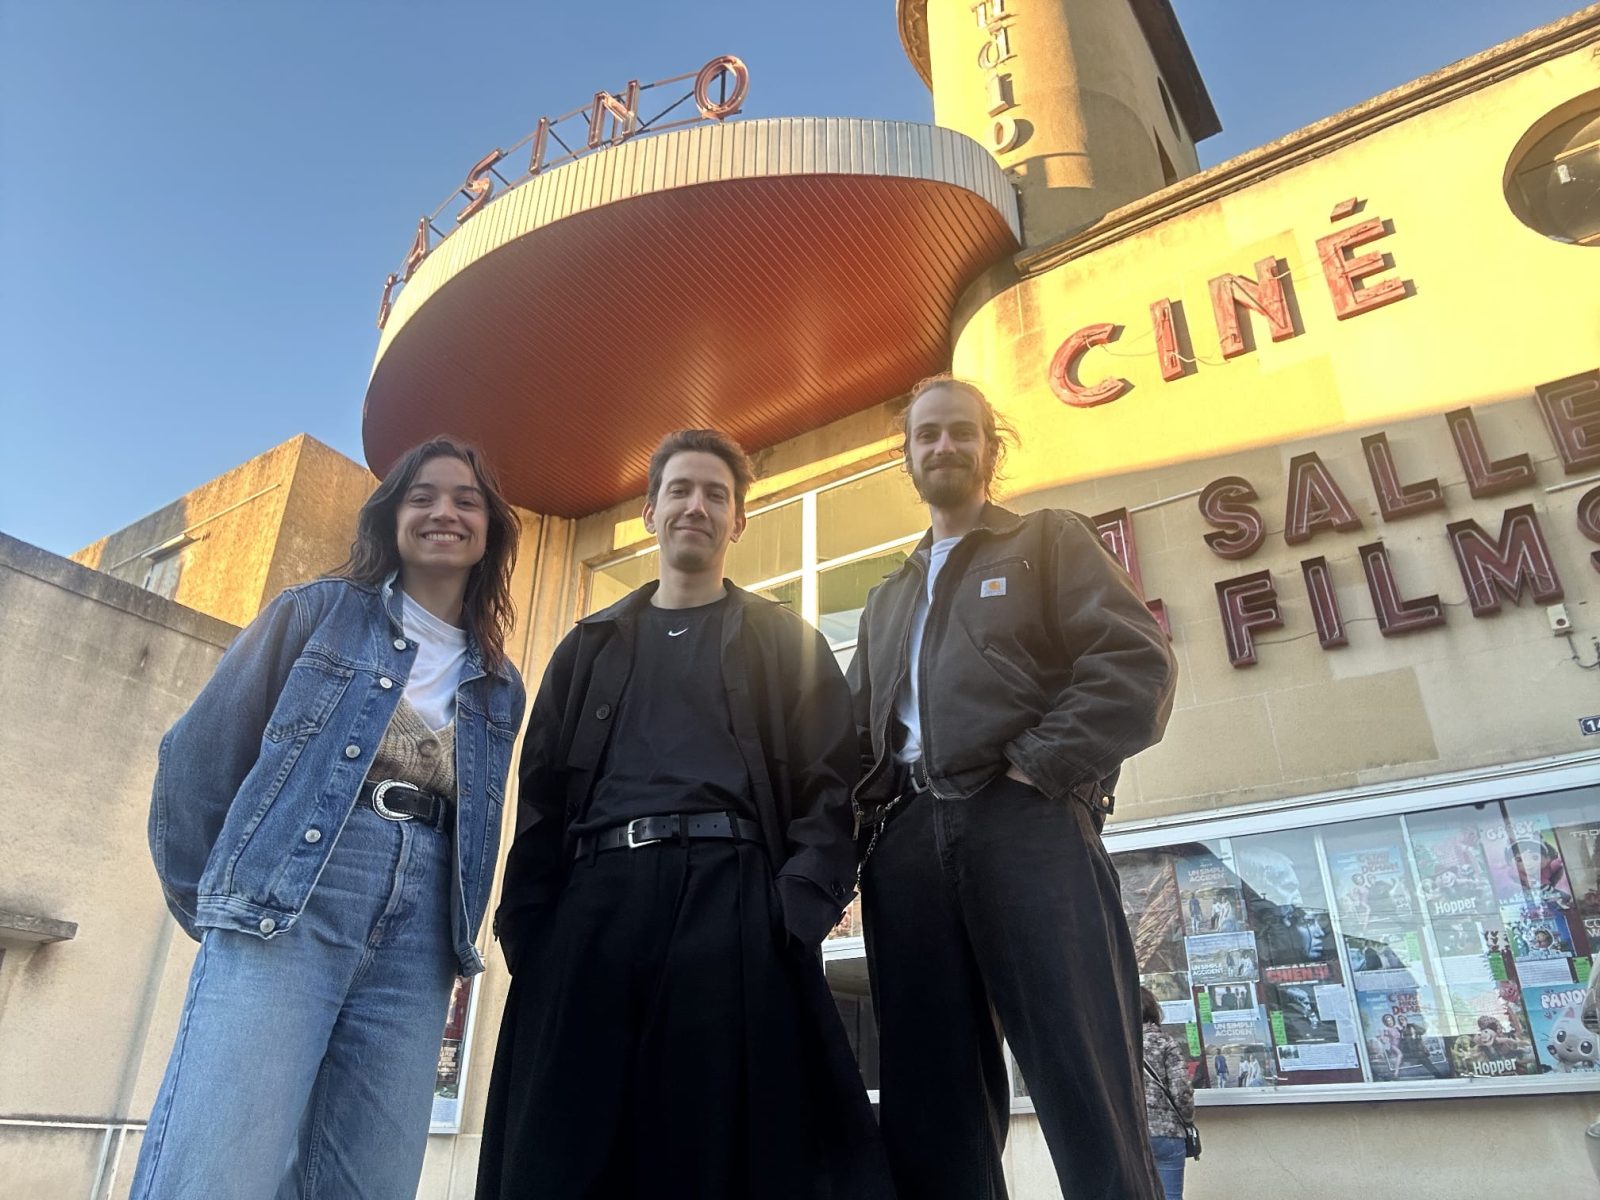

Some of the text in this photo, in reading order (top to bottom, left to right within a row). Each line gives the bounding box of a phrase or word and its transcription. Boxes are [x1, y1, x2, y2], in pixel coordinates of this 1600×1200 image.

[1049, 197, 1406, 408] CINÉ
[1199, 367, 1600, 560] SALLE
[1434, 896, 1476, 914] Hopper
[1473, 1058, 1517, 1075] Hopper
